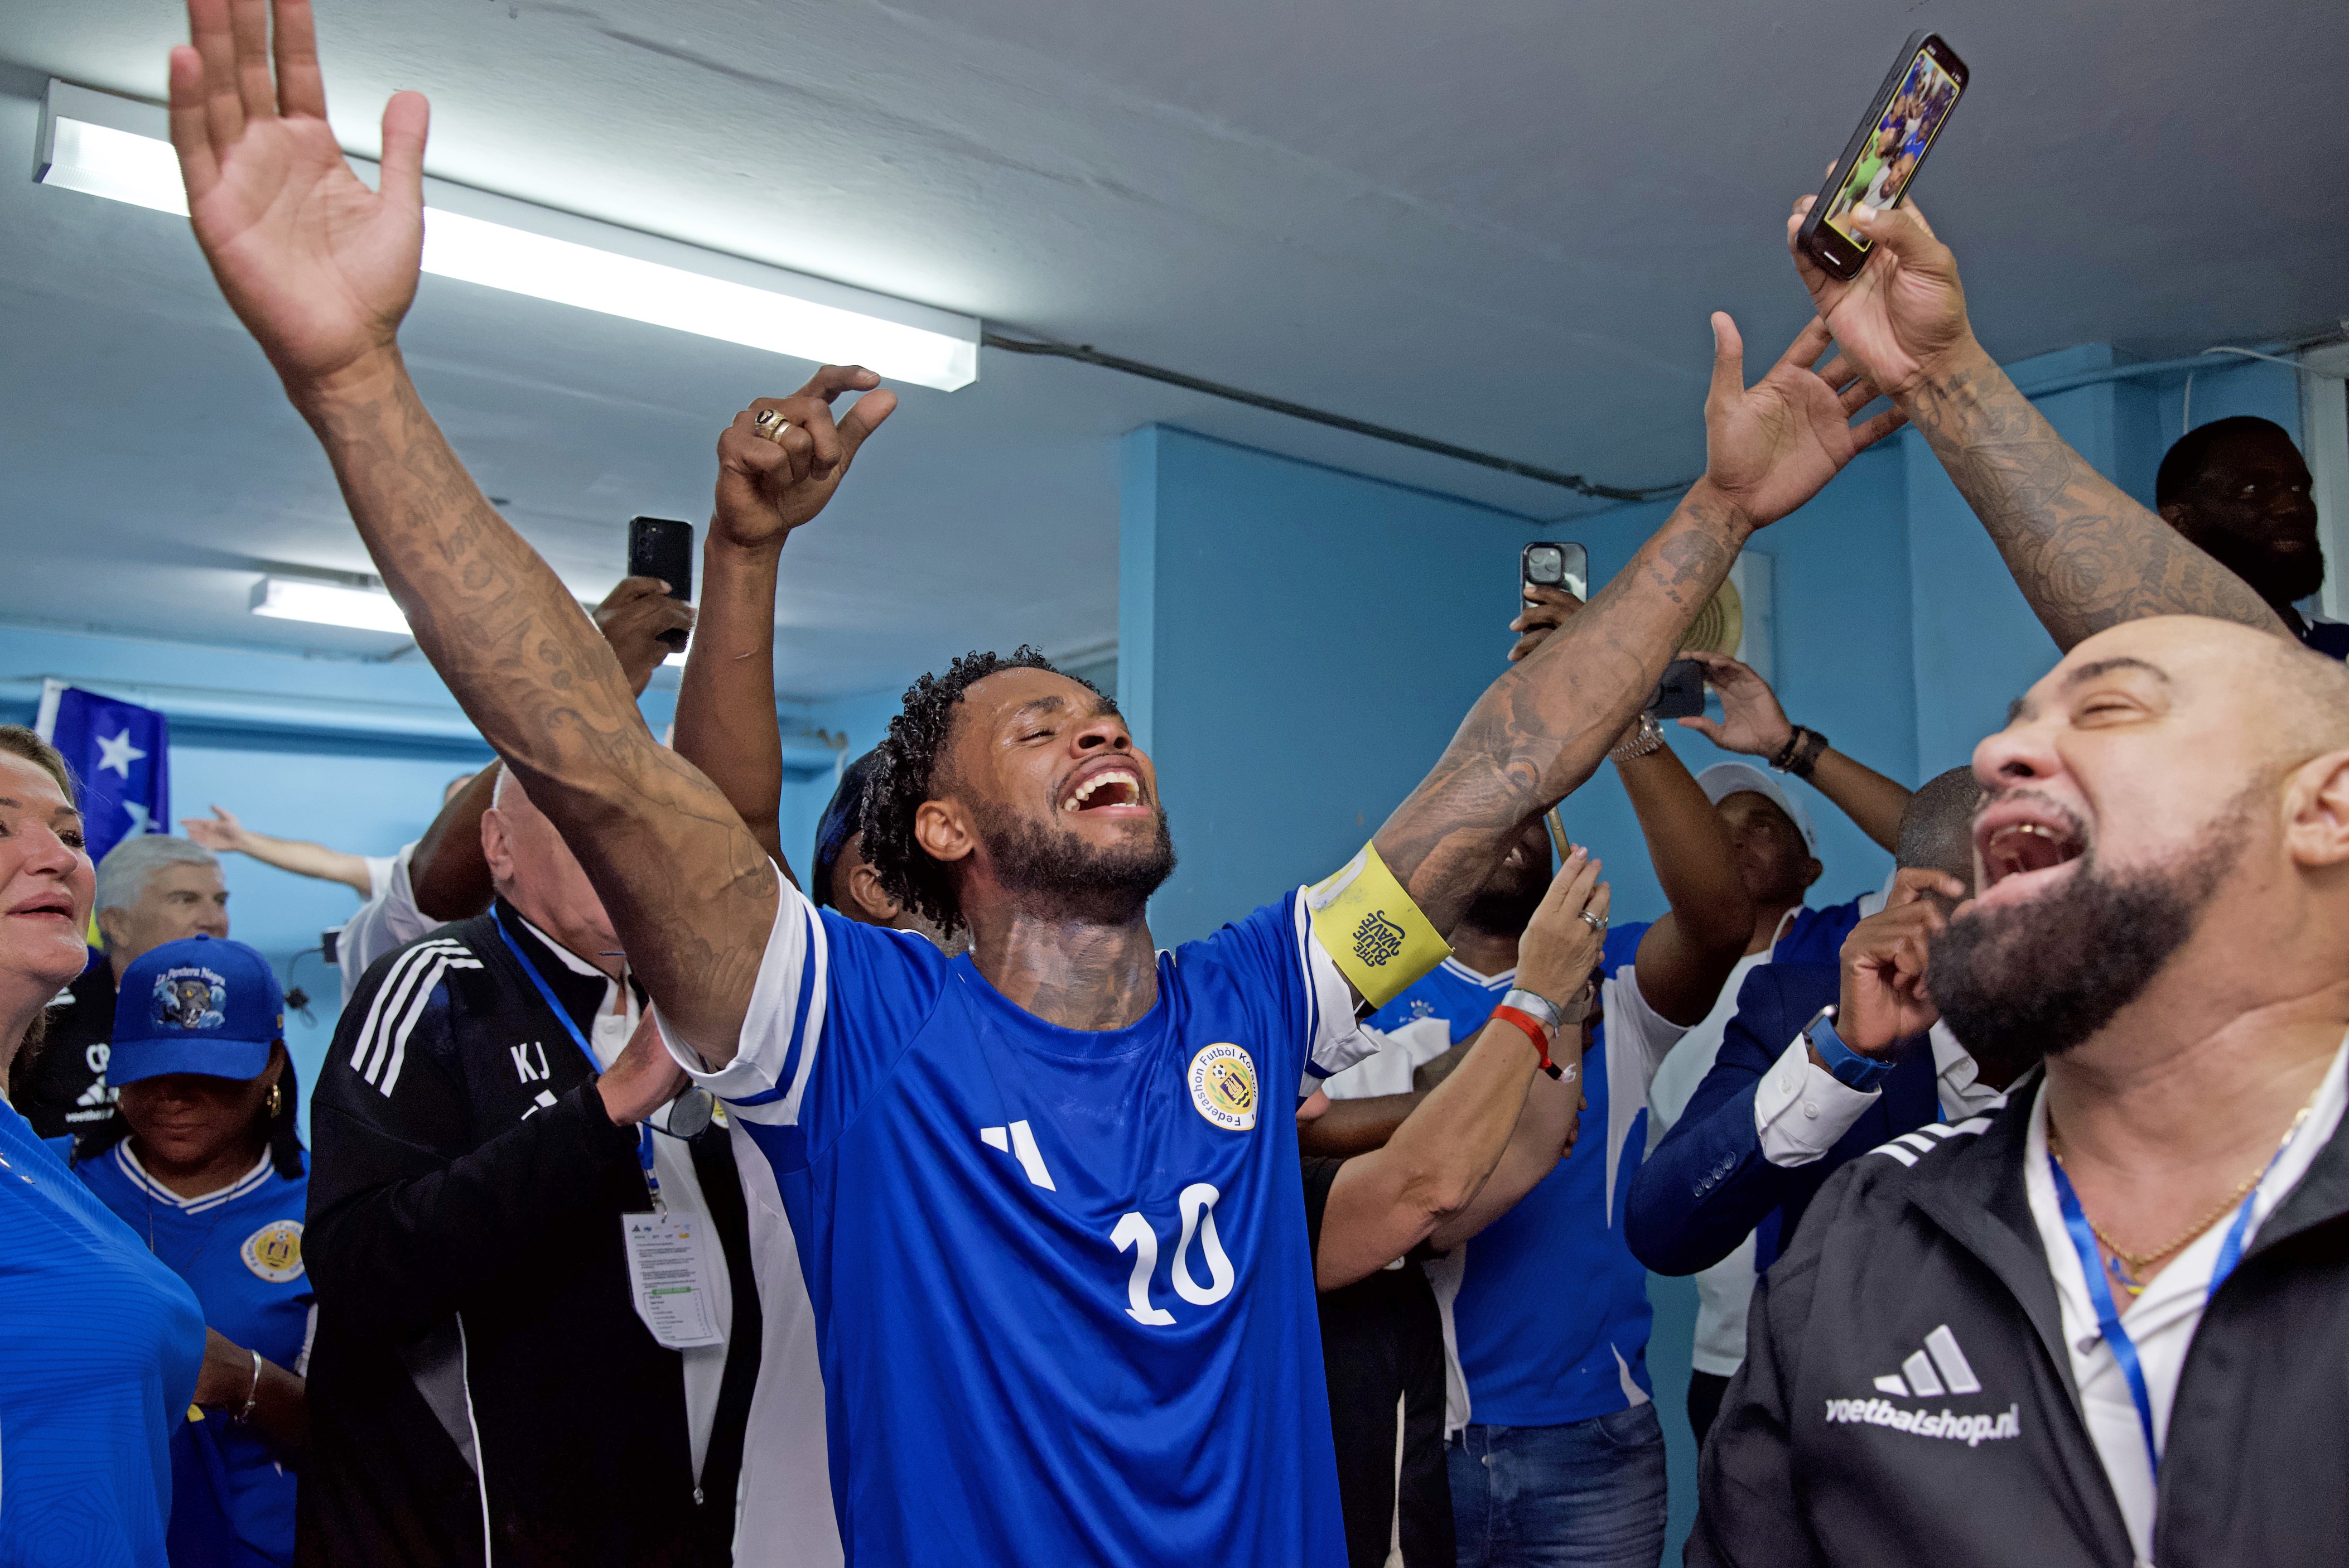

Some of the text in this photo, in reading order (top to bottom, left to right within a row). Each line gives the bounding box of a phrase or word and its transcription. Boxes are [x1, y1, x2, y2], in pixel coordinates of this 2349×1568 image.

[1353, 925, 1391, 966] BLUE
[1353, 942, 1375, 967] THE
[1361, 910, 1405, 956] WAVE
[510, 1041, 550, 1084] KJ
[1193, 1046, 1257, 1126] Federashon Futbòl Kòrsou
[1109, 1183, 1235, 1325] 10
[1825, 1397, 2021, 1448] voetbalshop.nl
